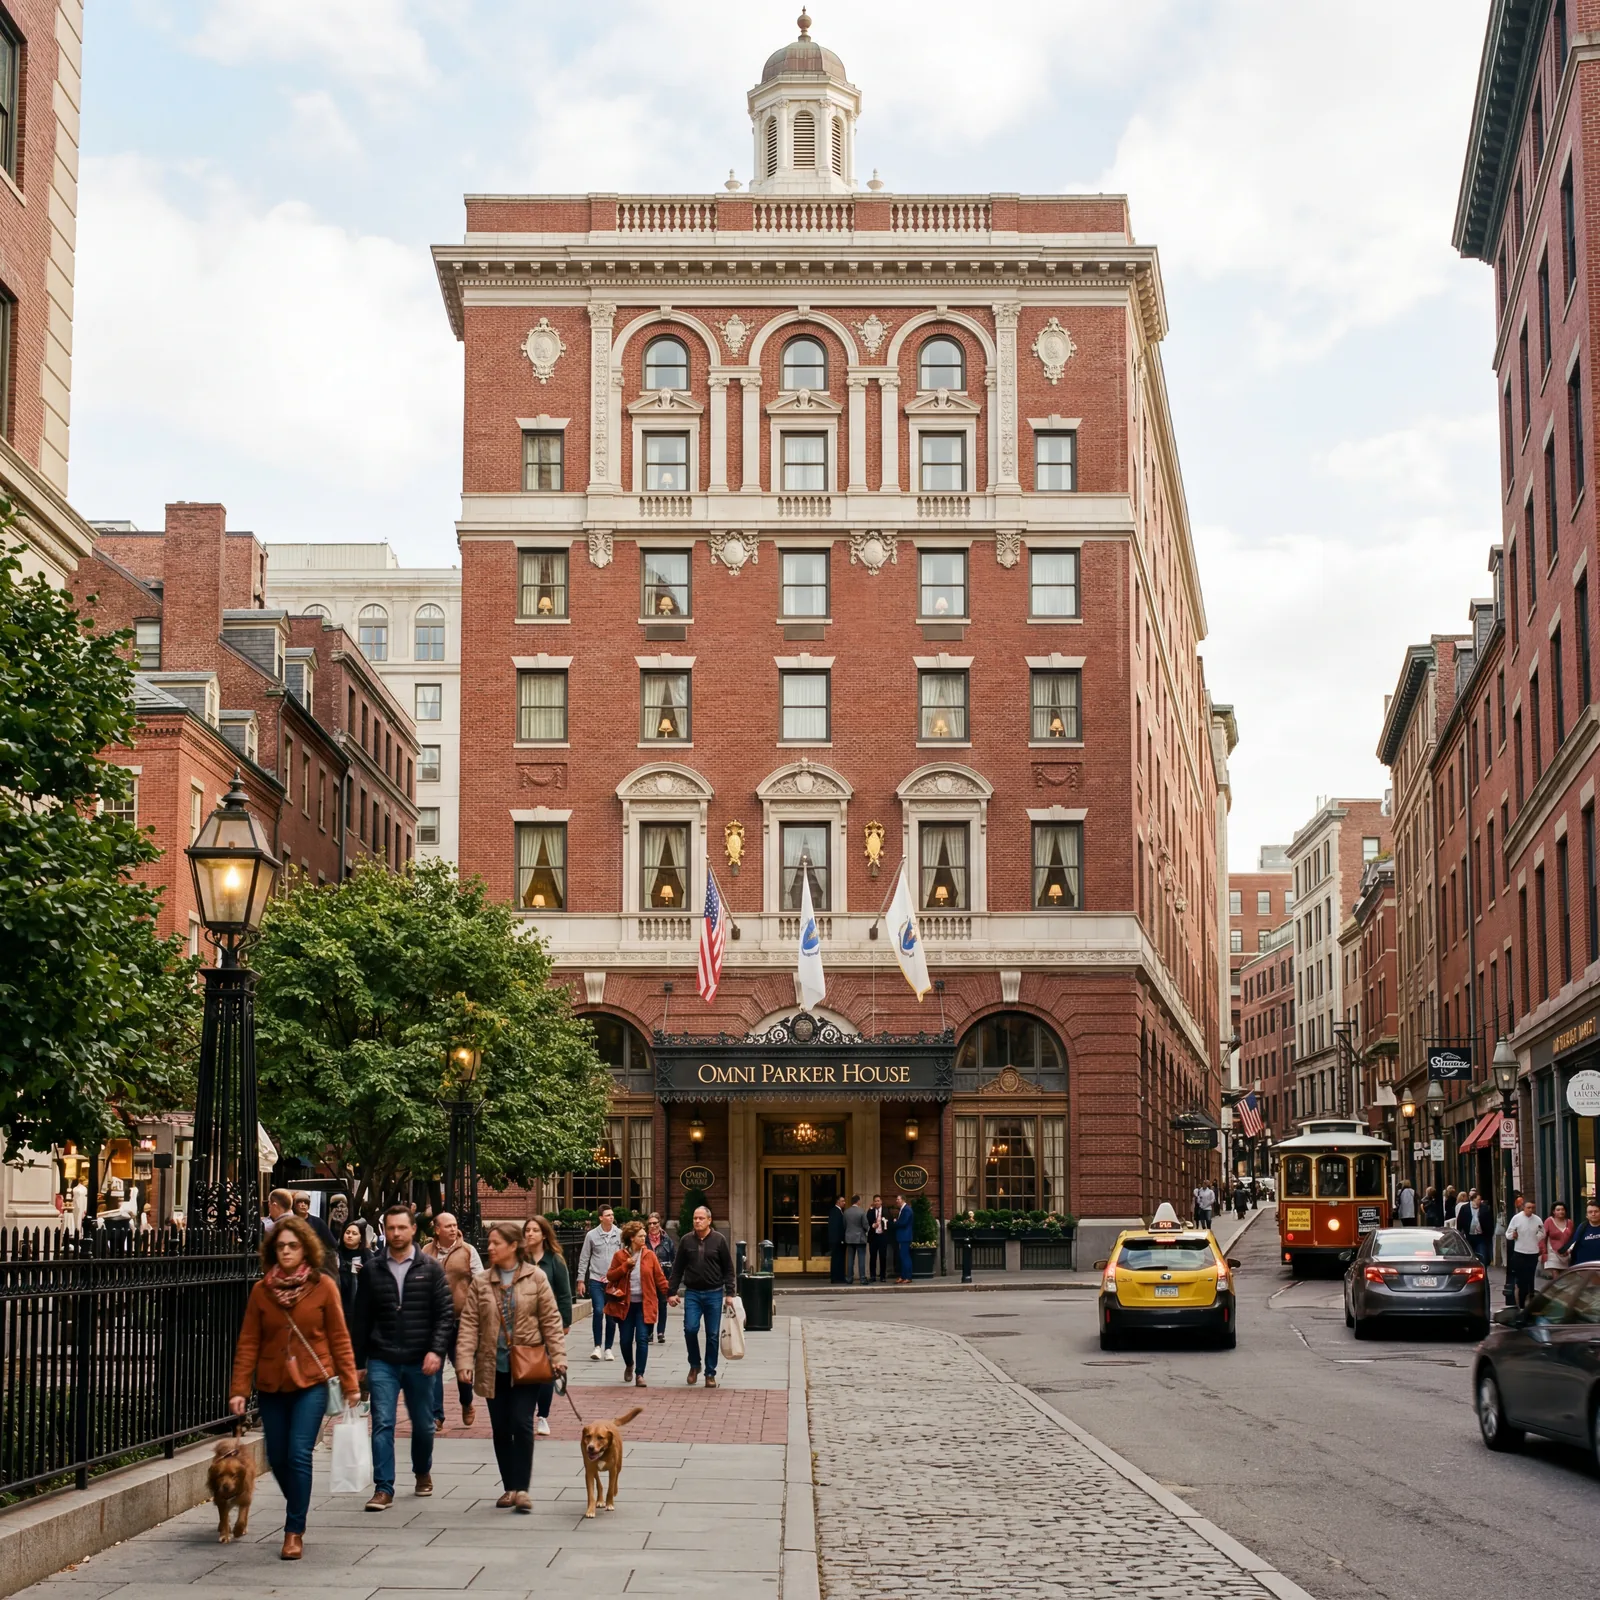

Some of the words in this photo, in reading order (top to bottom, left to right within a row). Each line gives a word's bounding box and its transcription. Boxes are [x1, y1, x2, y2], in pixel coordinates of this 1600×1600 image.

[698, 1063, 756, 1083] OMNI
[761, 1063, 836, 1083] PARKER
[842, 1063, 911, 1083] HOUSE
